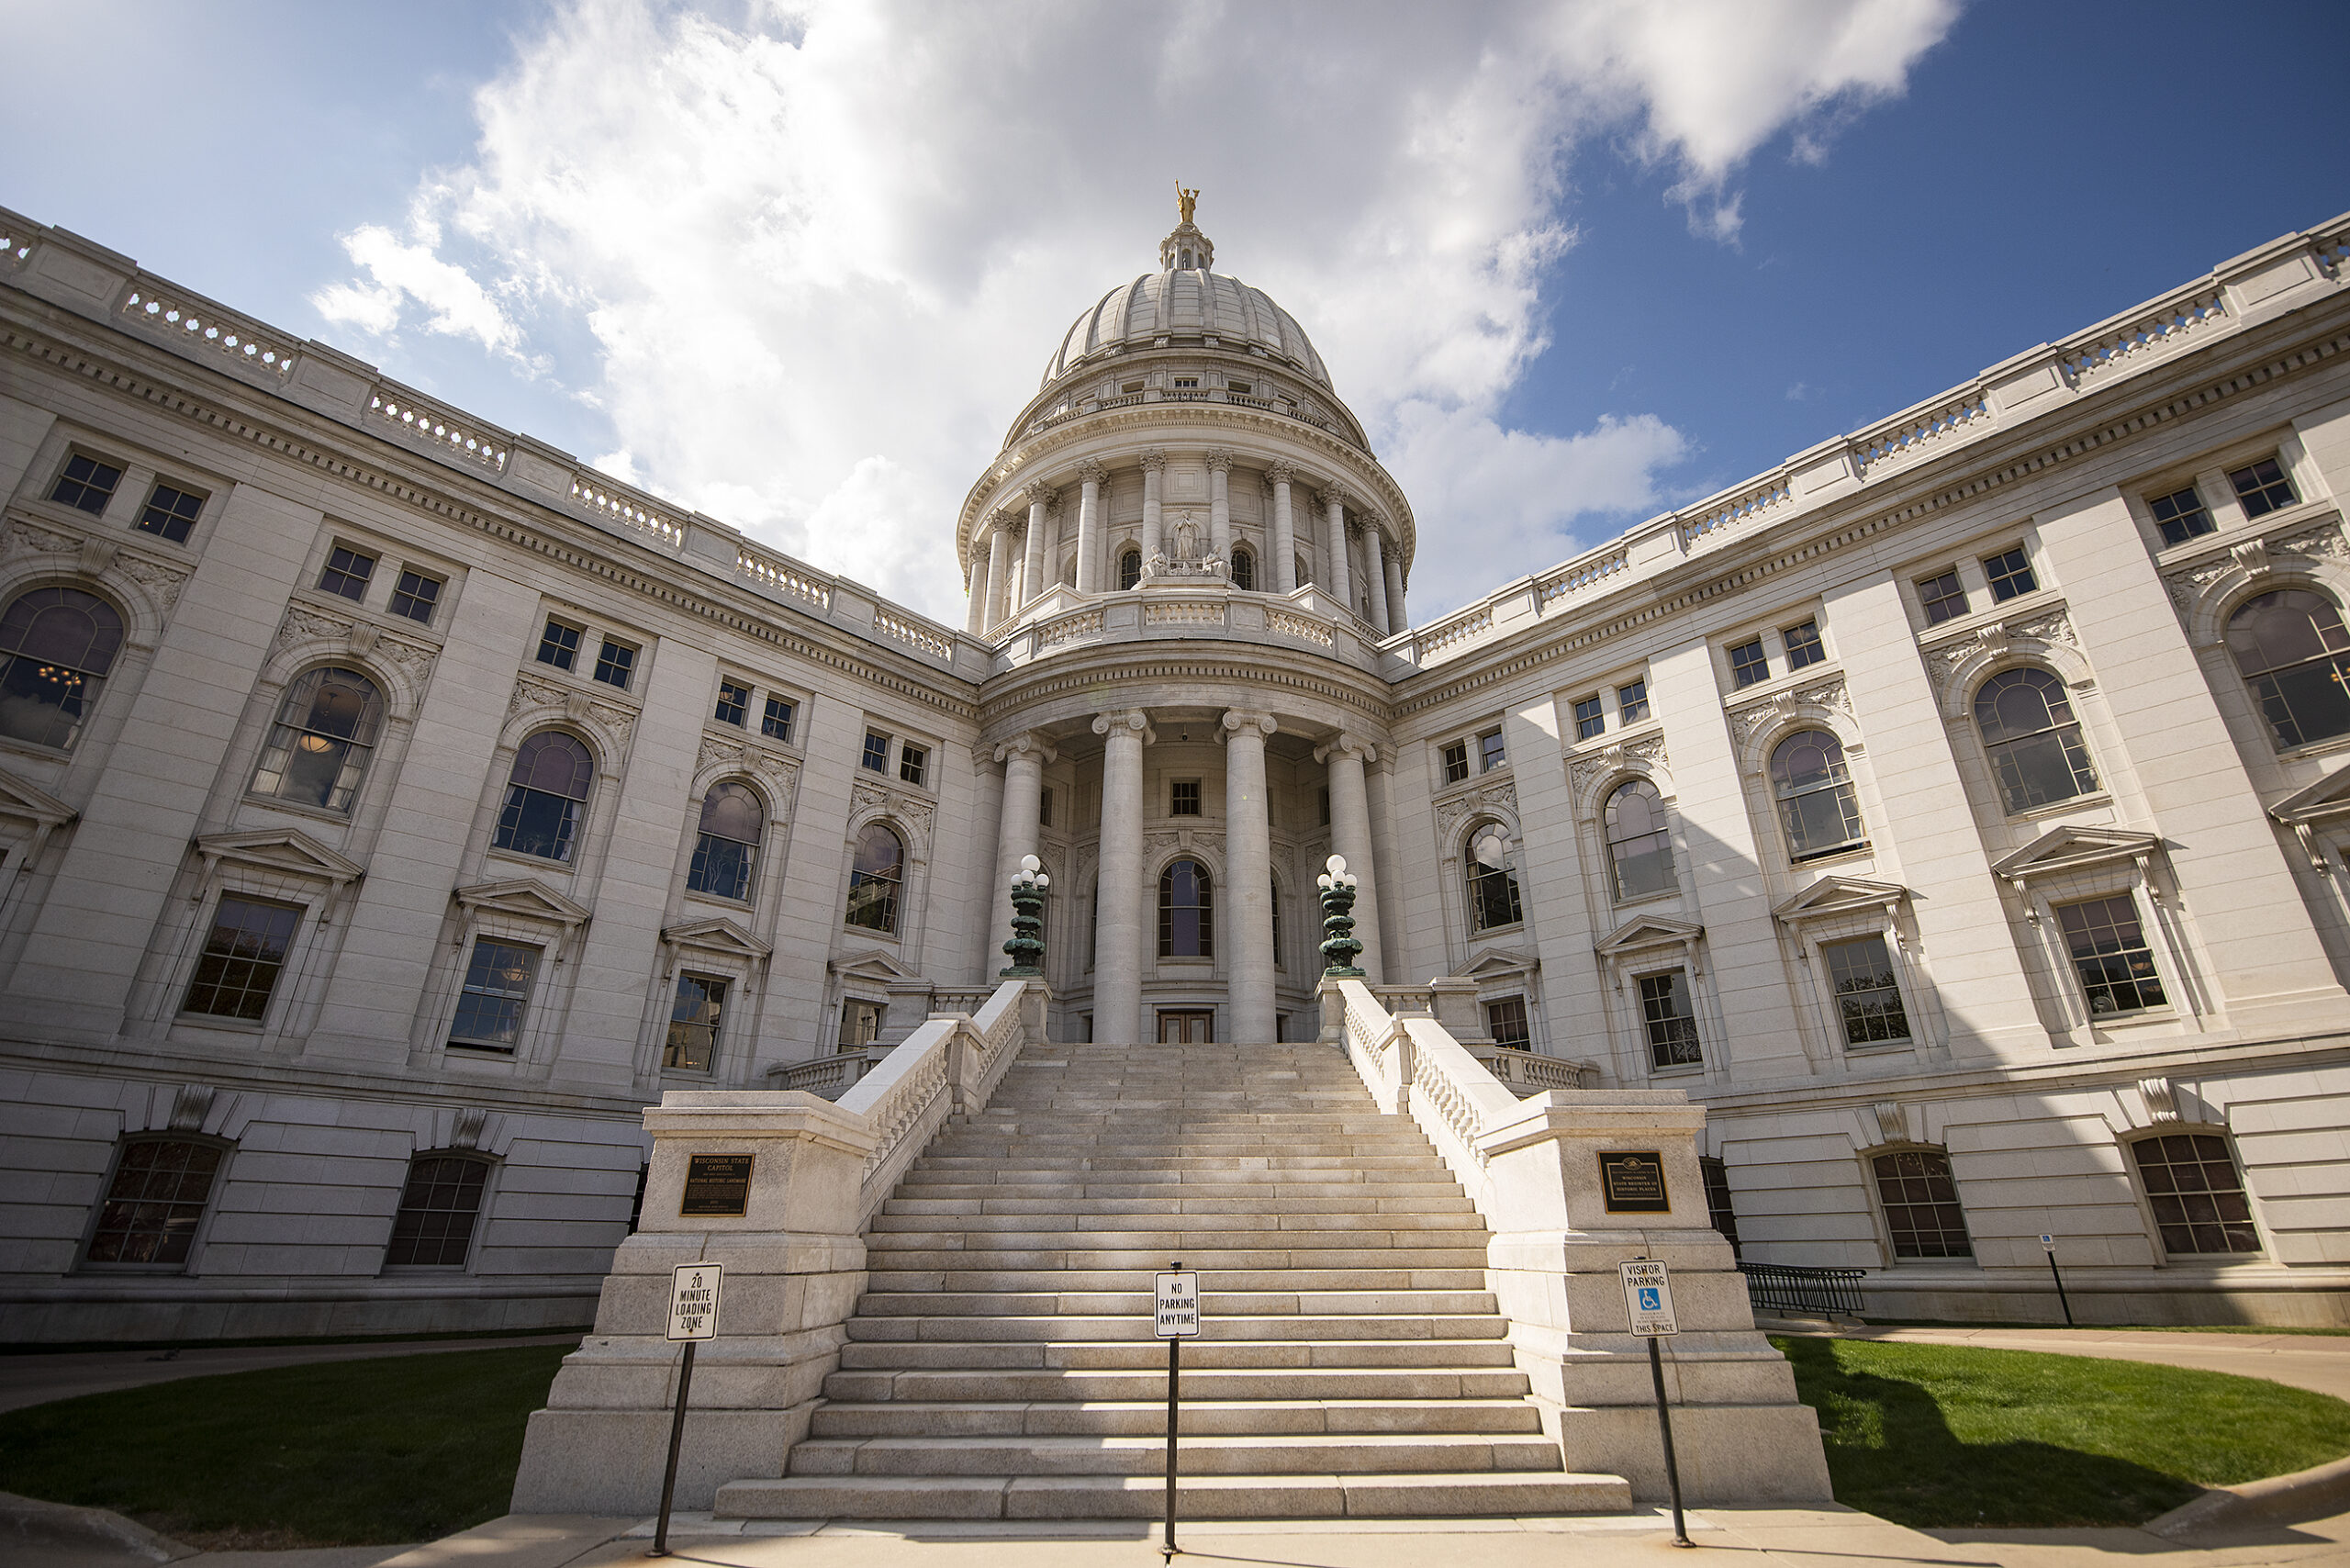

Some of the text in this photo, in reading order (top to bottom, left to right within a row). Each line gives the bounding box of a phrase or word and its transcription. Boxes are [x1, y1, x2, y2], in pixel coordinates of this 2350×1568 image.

[1627, 1264, 1661, 1275] VISITOR
[691, 1276, 702, 1288] 20
[1627, 1276, 1665, 1287] PARKING
[1171, 1282, 1182, 1294] NO
[679, 1289, 711, 1302] MINUTE
[676, 1302, 712, 1316] LOADING
[1159, 1297, 1195, 1309] PARKING
[680, 1316, 703, 1329] ZONE
[1159, 1313, 1195, 1325] ANYTIME
[1636, 1323, 1674, 1333] THIS SPACE
